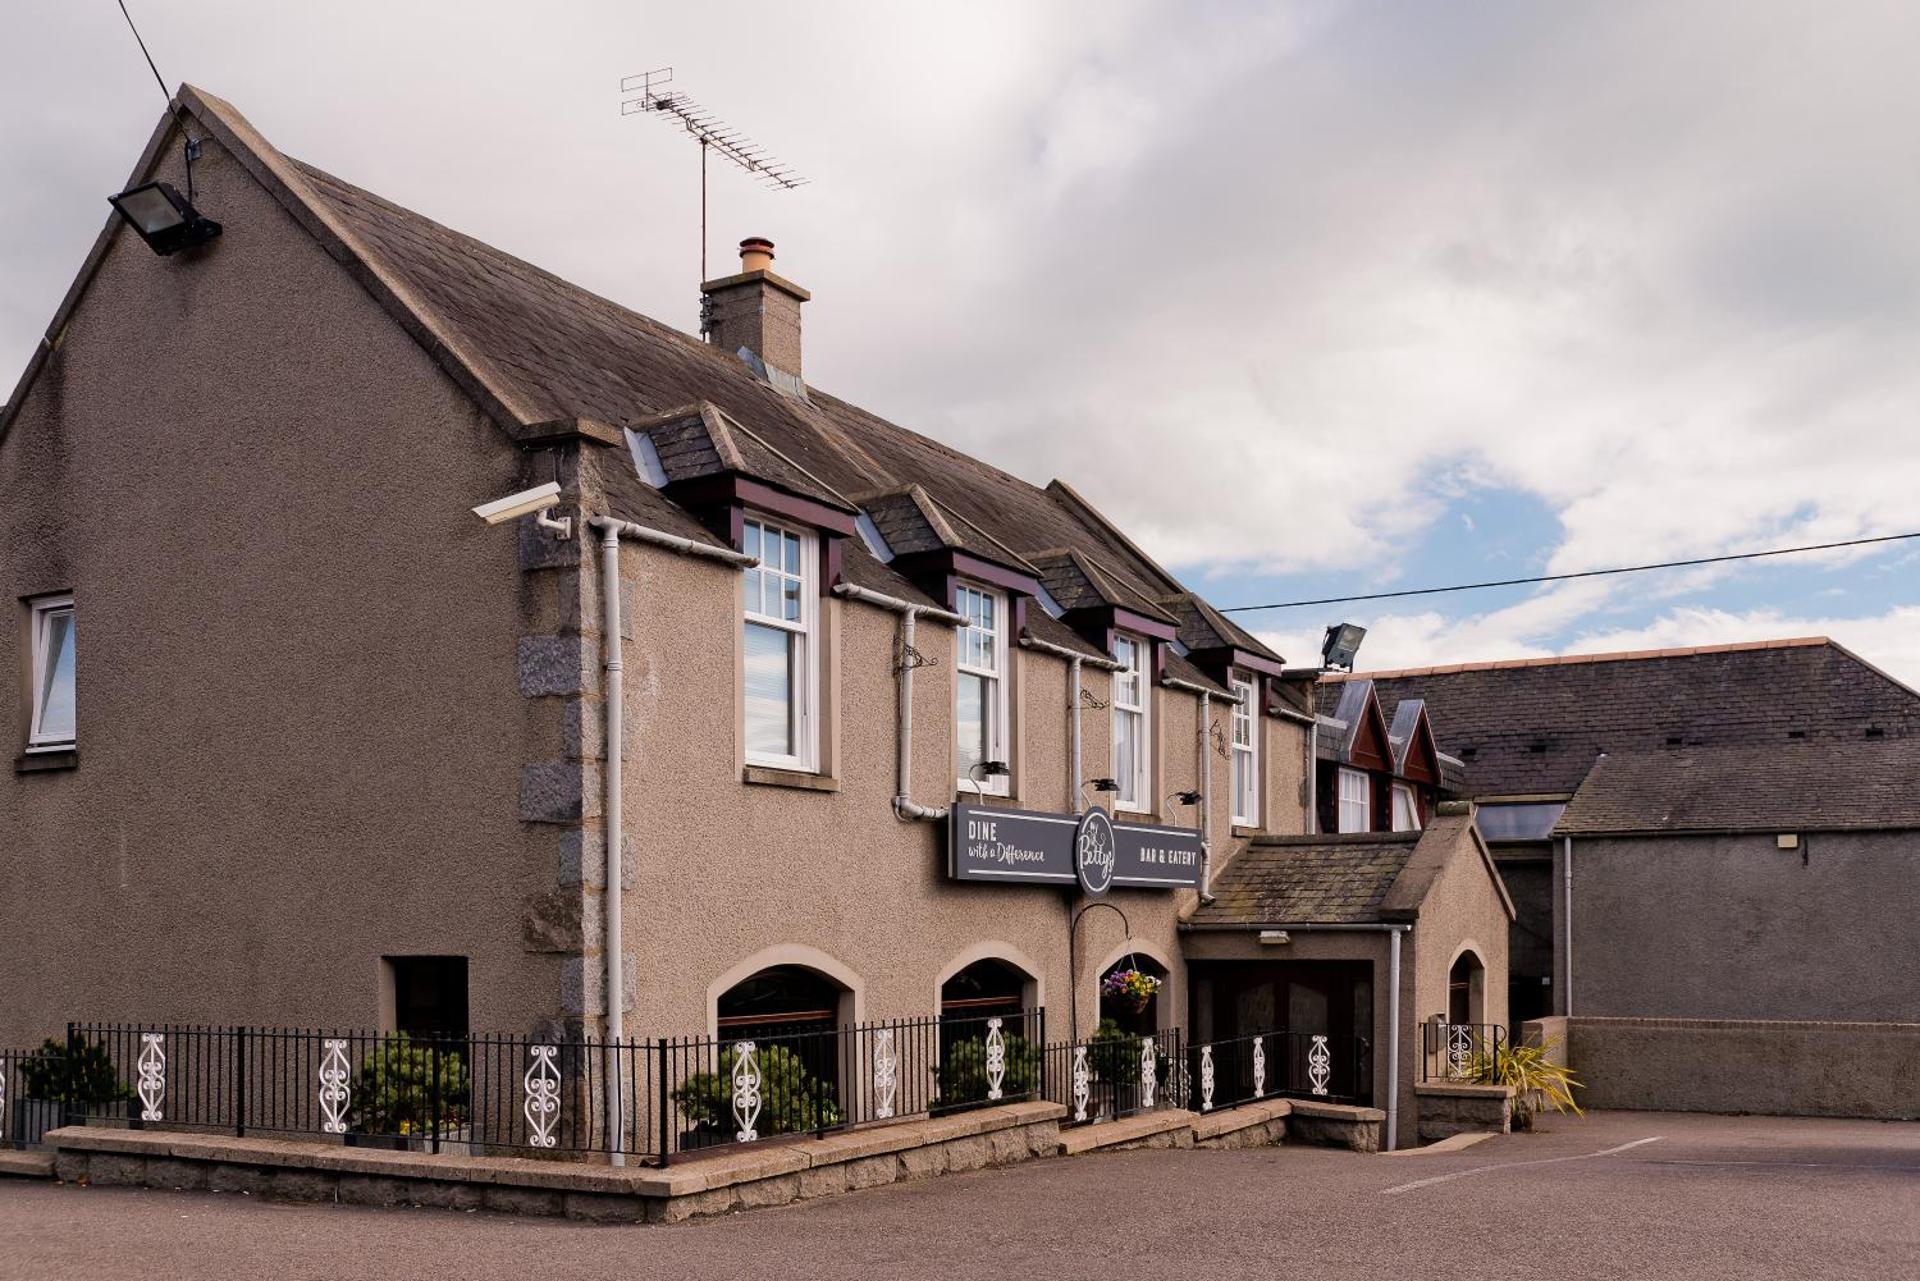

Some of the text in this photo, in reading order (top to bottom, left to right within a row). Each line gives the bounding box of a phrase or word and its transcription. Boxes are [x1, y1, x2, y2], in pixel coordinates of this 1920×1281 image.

[968, 820, 997, 841] DINE
[968, 842, 1045, 865] with a Difference
[1140, 847, 1197, 866] BAR & EATERY
